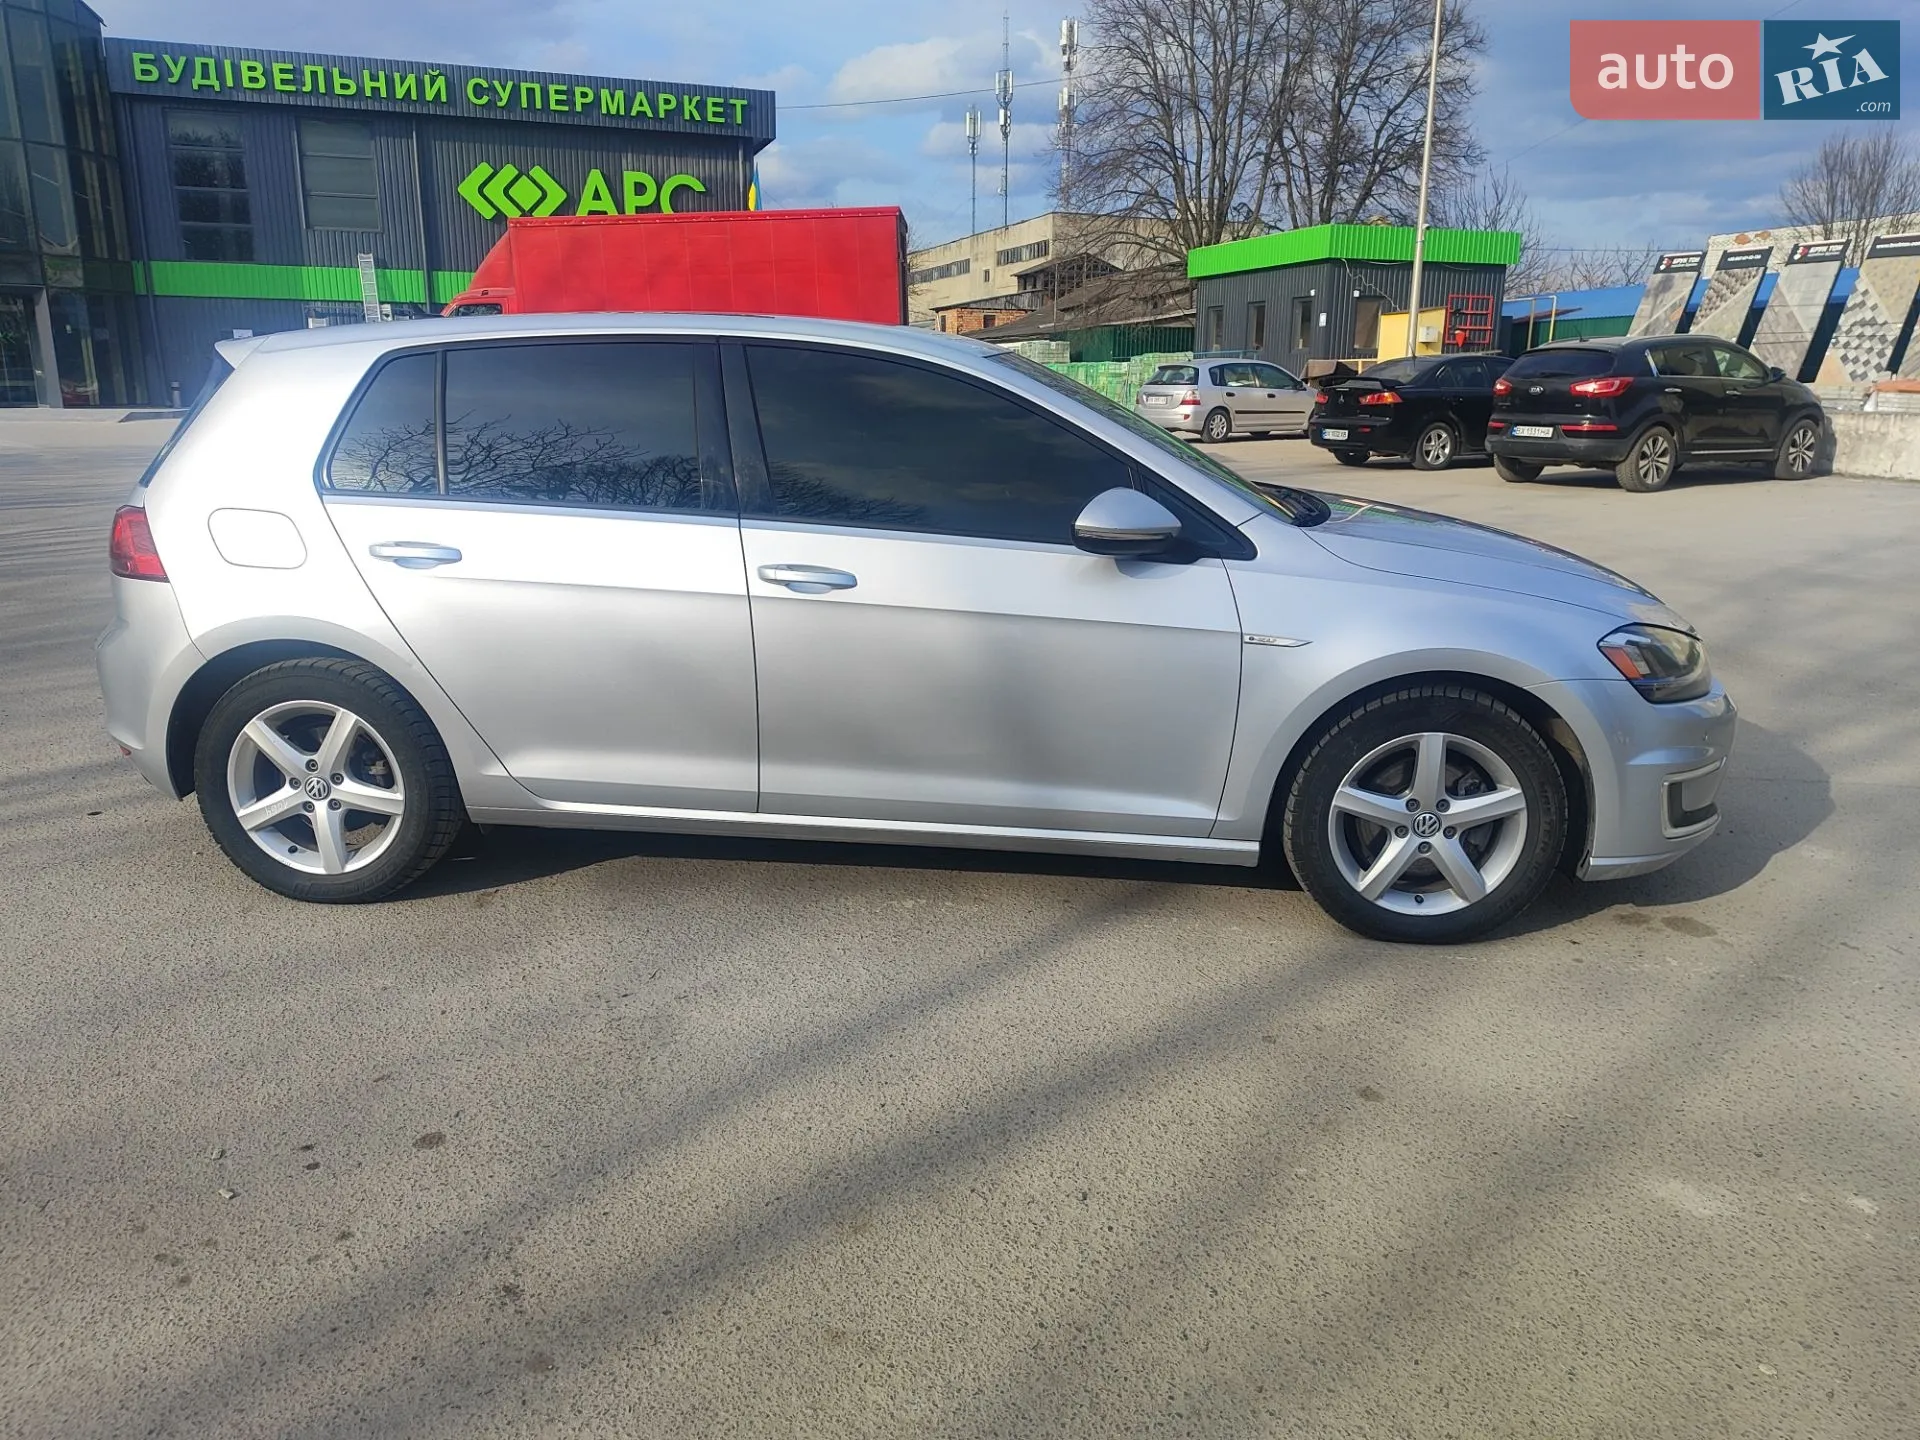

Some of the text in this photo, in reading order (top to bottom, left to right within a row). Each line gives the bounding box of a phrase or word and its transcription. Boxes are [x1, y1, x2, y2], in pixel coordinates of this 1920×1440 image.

[131, 51, 749, 125] БУДІВЕЛЬНИЙ СУПЕРМАРКЕТ
[576, 169, 706, 217] АРС
